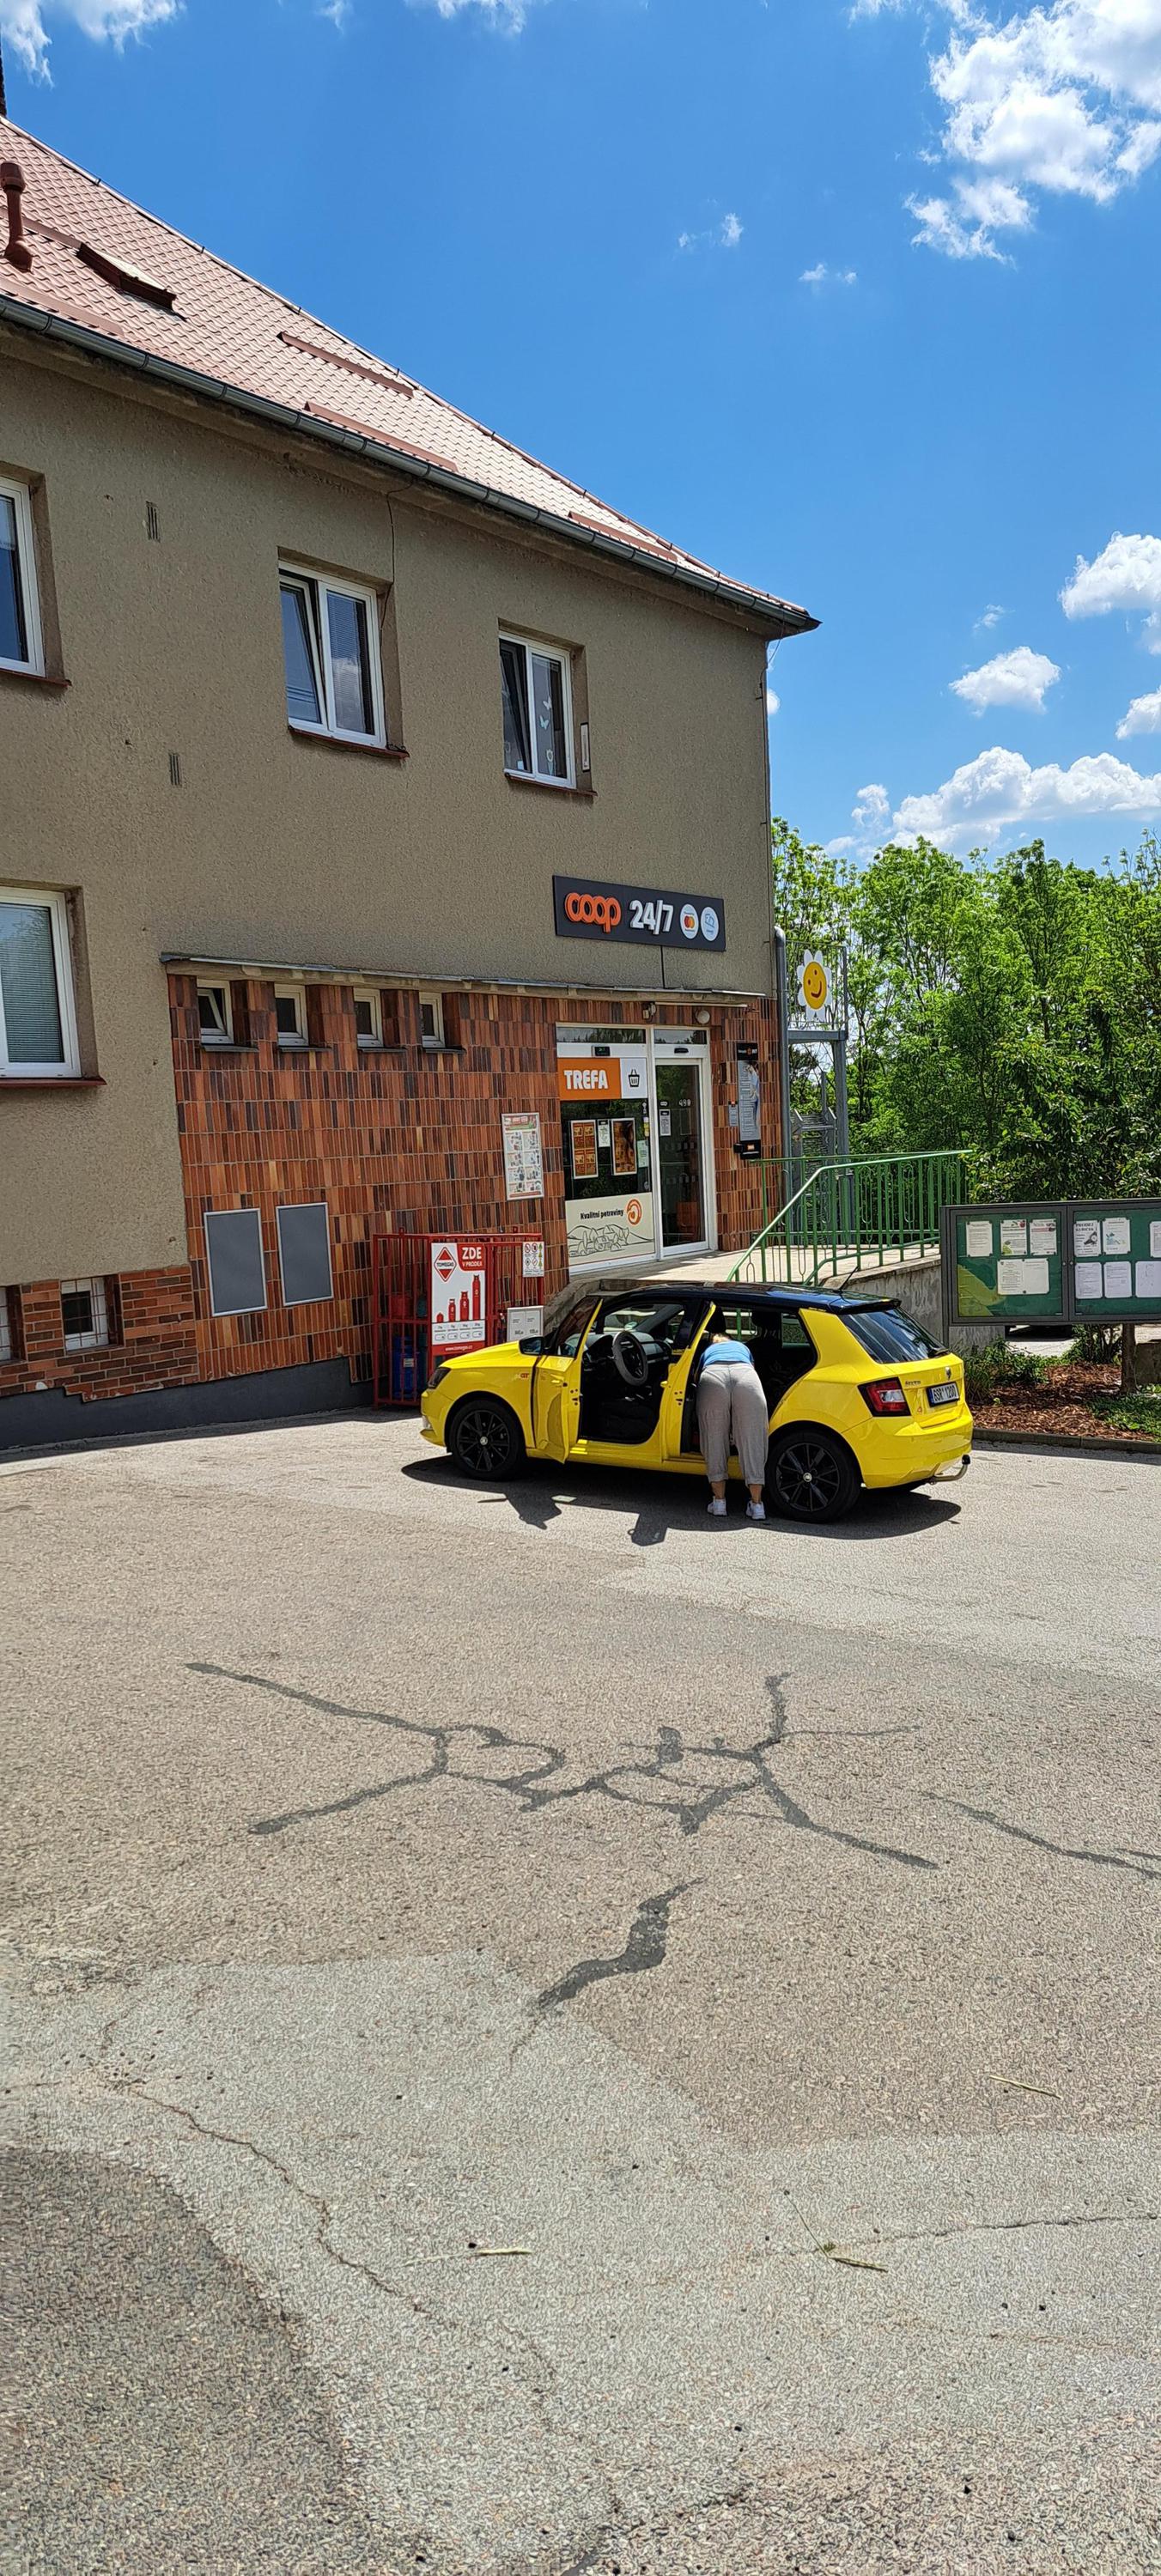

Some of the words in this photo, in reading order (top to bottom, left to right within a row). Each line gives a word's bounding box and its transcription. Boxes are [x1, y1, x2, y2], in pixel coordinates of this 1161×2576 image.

[565, 892, 621, 933] coop
[629, 899, 674, 935] 24/7
[563, 1069, 609, 1090] TREFA
[580, 1210, 600, 1219] Kvalitní
[600, 1208, 624, 1218] potraviny
[462, 1246, 483, 1260] ZDE
